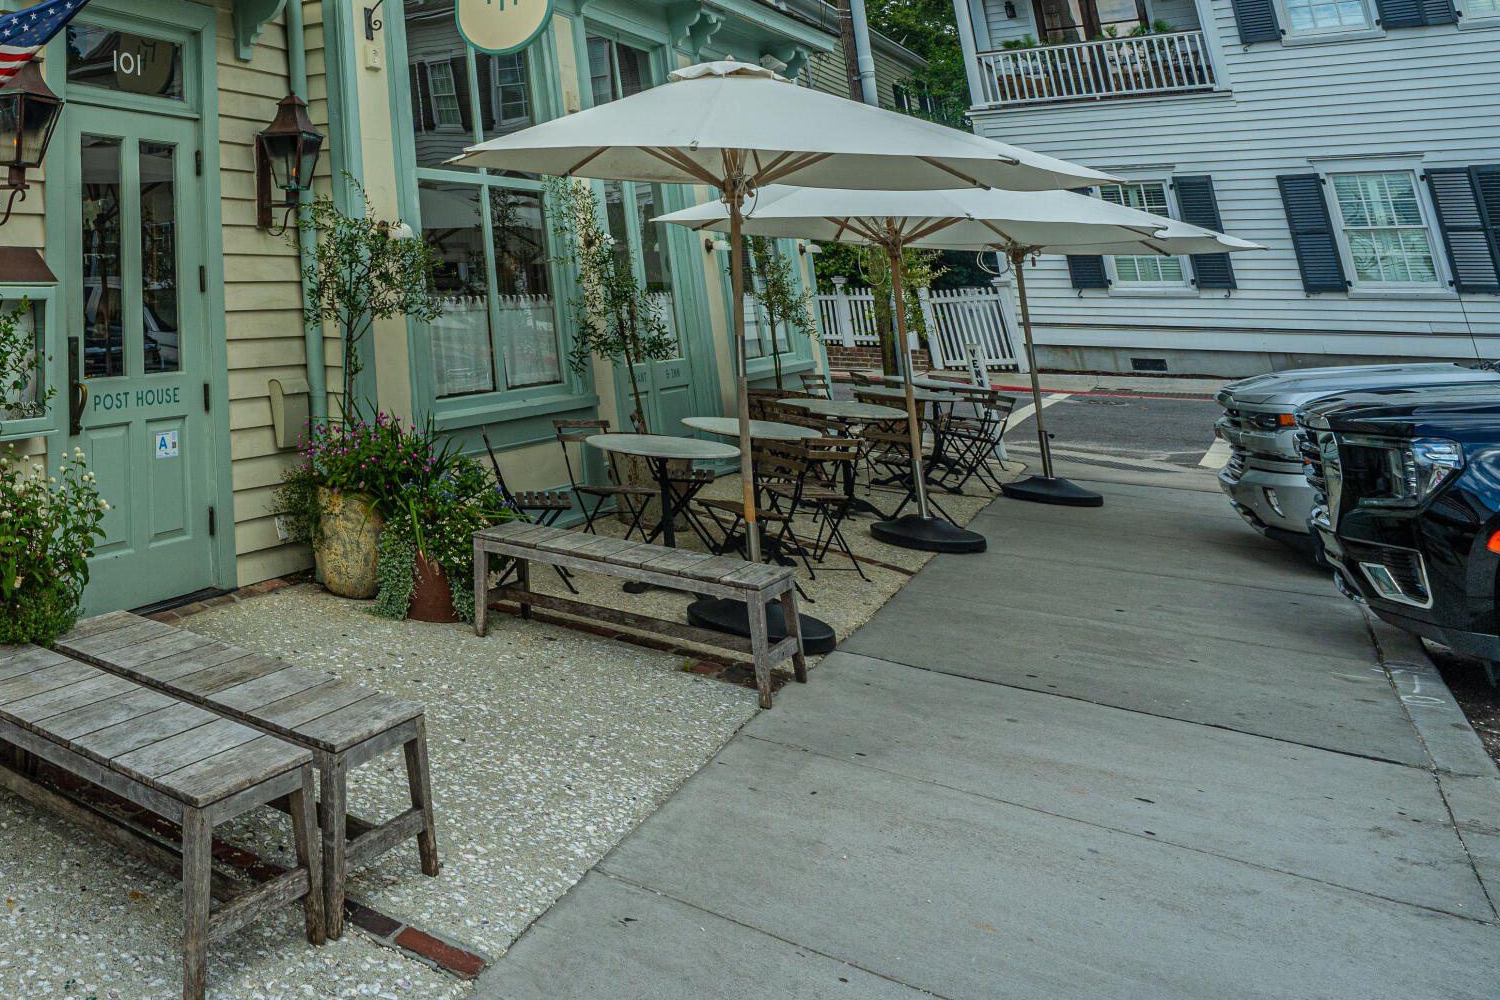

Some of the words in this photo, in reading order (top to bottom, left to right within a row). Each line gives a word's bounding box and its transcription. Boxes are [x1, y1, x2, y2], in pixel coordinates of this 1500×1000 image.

[113, 50, 141, 76] 101
[94, 391, 130, 411] POST
[136, 387, 181, 407] HOUSE
[159, 436, 168, 450] A
